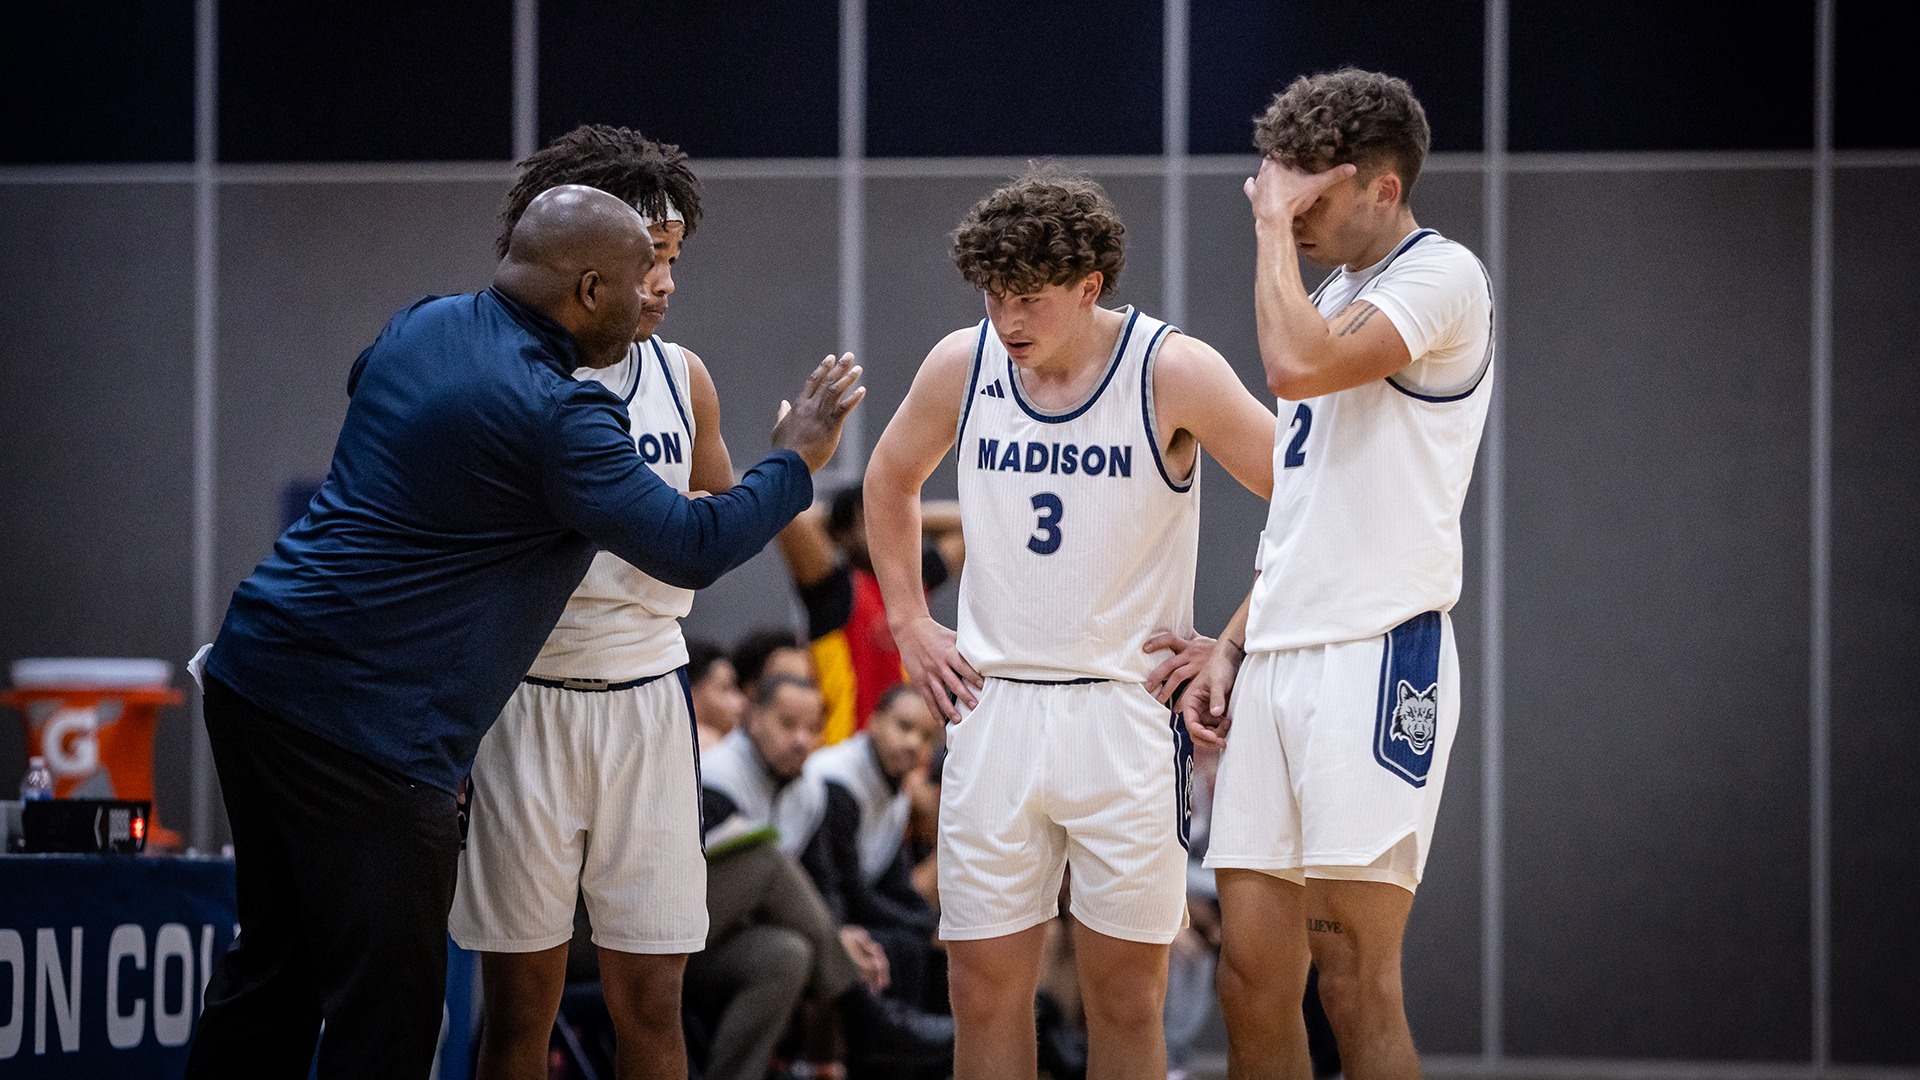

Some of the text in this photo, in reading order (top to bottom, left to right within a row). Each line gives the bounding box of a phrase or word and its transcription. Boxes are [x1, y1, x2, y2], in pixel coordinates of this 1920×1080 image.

[977, 437, 1132, 478] MADISON
[1284, 402, 1312, 470] 2
[1025, 491, 1063, 556] 3
[42, 708, 98, 775] G
